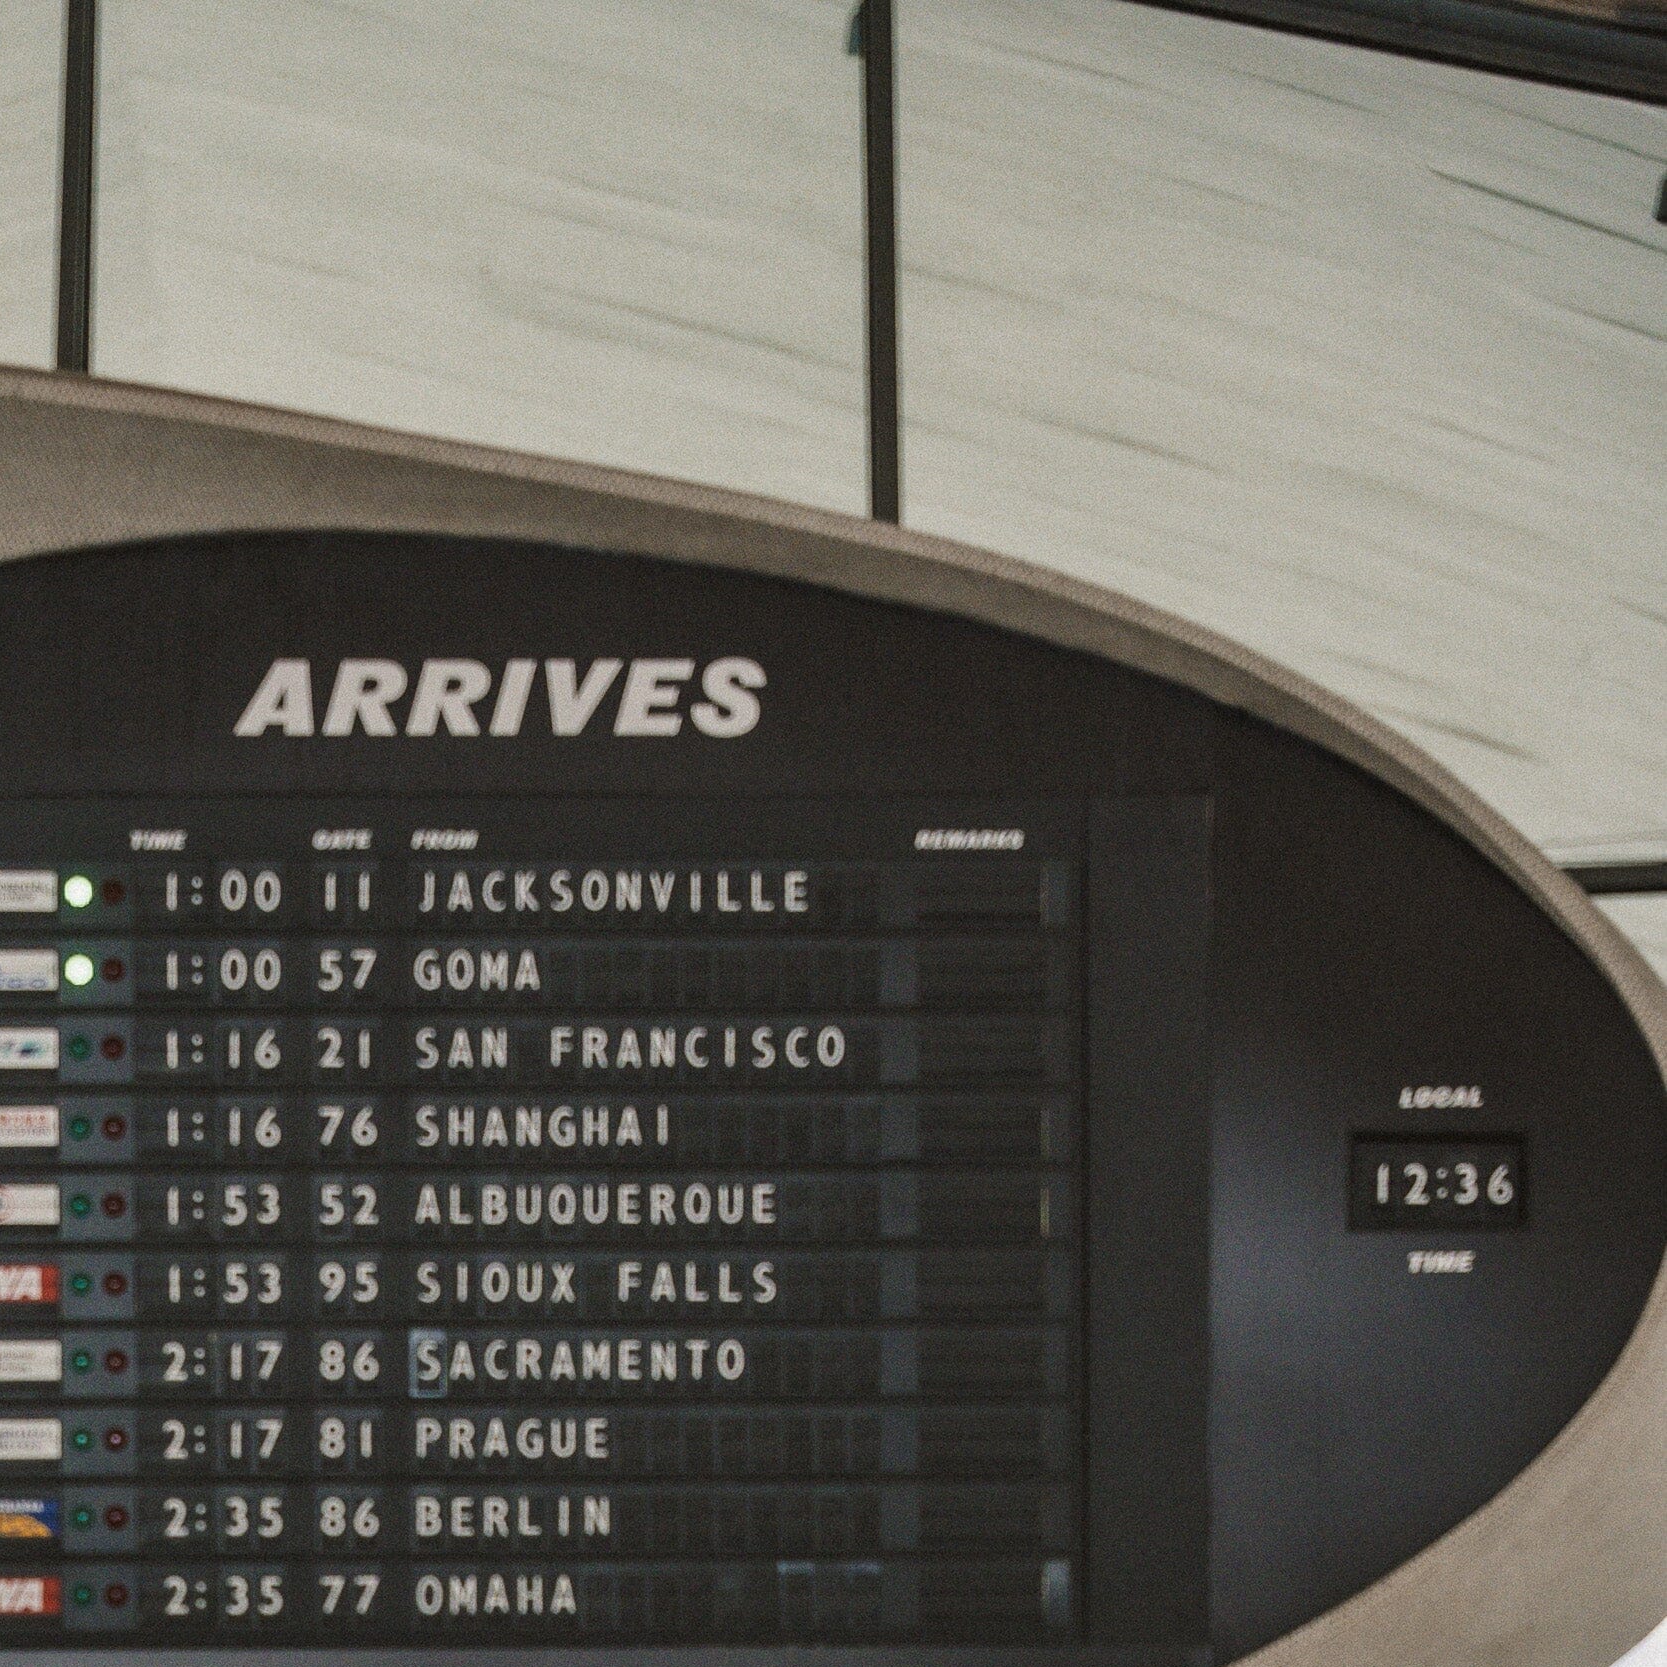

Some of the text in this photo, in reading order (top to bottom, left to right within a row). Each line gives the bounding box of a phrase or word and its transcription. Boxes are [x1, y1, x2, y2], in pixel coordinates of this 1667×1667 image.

[233, 657, 767, 739] ARRIVES
[129, 829, 187, 851] TIME
[311, 829, 372, 851] GATE
[165, 869, 282, 913] 1:00
[324, 872, 371, 911] 11
[419, 869, 808, 913] JACKSONVILLE
[165, 948, 282, 991] 1:00
[317, 948, 377, 992] 57
[413, 948, 541, 992] GOMA
[165, 1028, 281, 1070] 1:16
[317, 1026, 371, 1069] 21
[415, 1026, 508, 1070] SAN
[549, 1025, 846, 1069] FRANCISCO
[166, 1107, 282, 1148] 1:16
[318, 1104, 378, 1147] 76
[415, 1104, 669, 1148] SHANGHAI
[166, 1182, 281, 1227] 1:53
[318, 1182, 379, 1226] 52
[414, 1182, 776, 1226] ALBUQUERQUE
[1376, 1162, 1513, 1205] 12:36
[167, 1261, 282, 1305] 1:53
[318, 1260, 379, 1303] 95
[416, 1260, 576, 1304] SIOUX
[617, 1261, 777, 1304] FALLS
[162, 1339, 283, 1383] 2:17
[318, 1339, 380, 1382] 86
[415, 1339, 746, 1382] SACRAMENTO
[162, 1418, 283, 1461] 2:17
[318, 1416, 373, 1459] 81
[415, 1417, 608, 1460] PRAGUE
[163, 1495, 284, 1538] 2:35
[319, 1495, 380, 1538] 86
[414, 1495, 611, 1537] BERLIN
[164, 1574, 284, 1616] 2:35
[319, 1574, 380, 1614] 77
[415, 1574, 577, 1616] OMAHA
